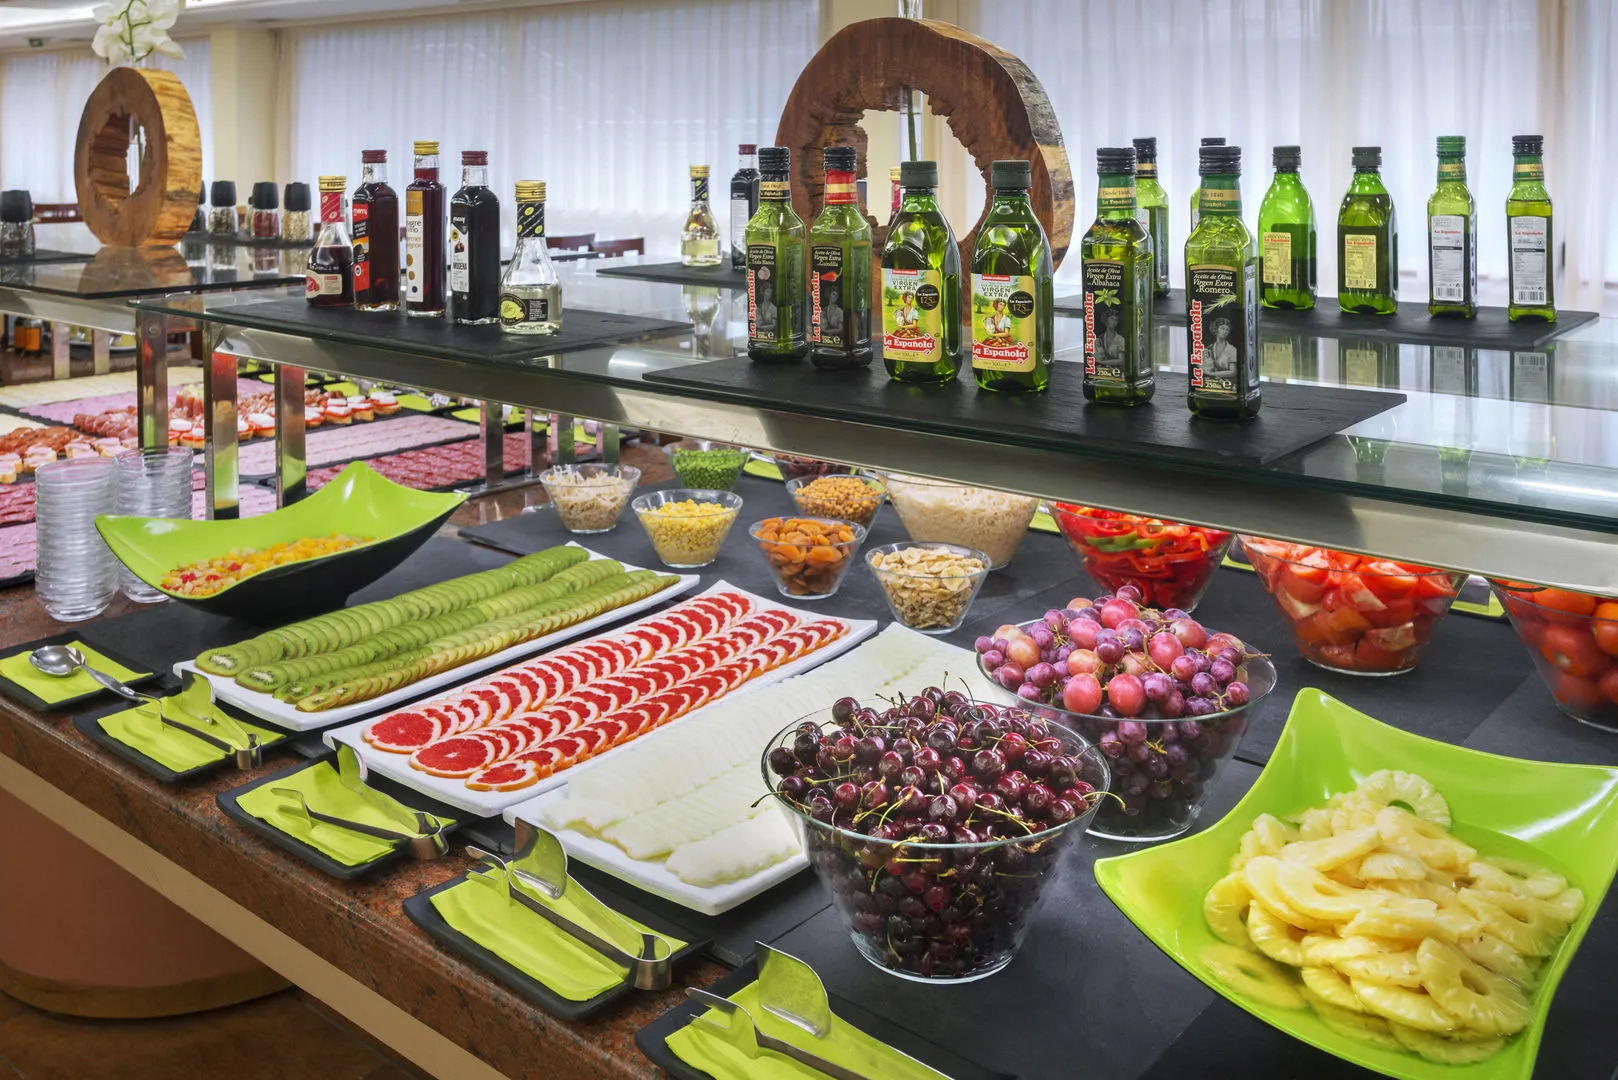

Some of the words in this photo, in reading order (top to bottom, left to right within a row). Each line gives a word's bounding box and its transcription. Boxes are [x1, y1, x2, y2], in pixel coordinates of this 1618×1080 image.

[1086, 272, 1104, 280] Virgen
[1091, 279, 1120, 287] Albahaca
[1193, 279, 1213, 288] Virgen
[1214, 279, 1233, 287] Extra
[1199, 285, 1231, 294] Romero
[1084, 292, 1096, 354] Española
[813, 327, 821, 342] La
[1190, 299, 1204, 365] Española
[884, 336, 892, 345] La
[894, 338, 933, 349] Española
[972, 346, 981, 354] La
[983, 347, 1026, 358] Española
[1085, 356, 1096, 375] La
[1191, 368, 1204, 387] La
